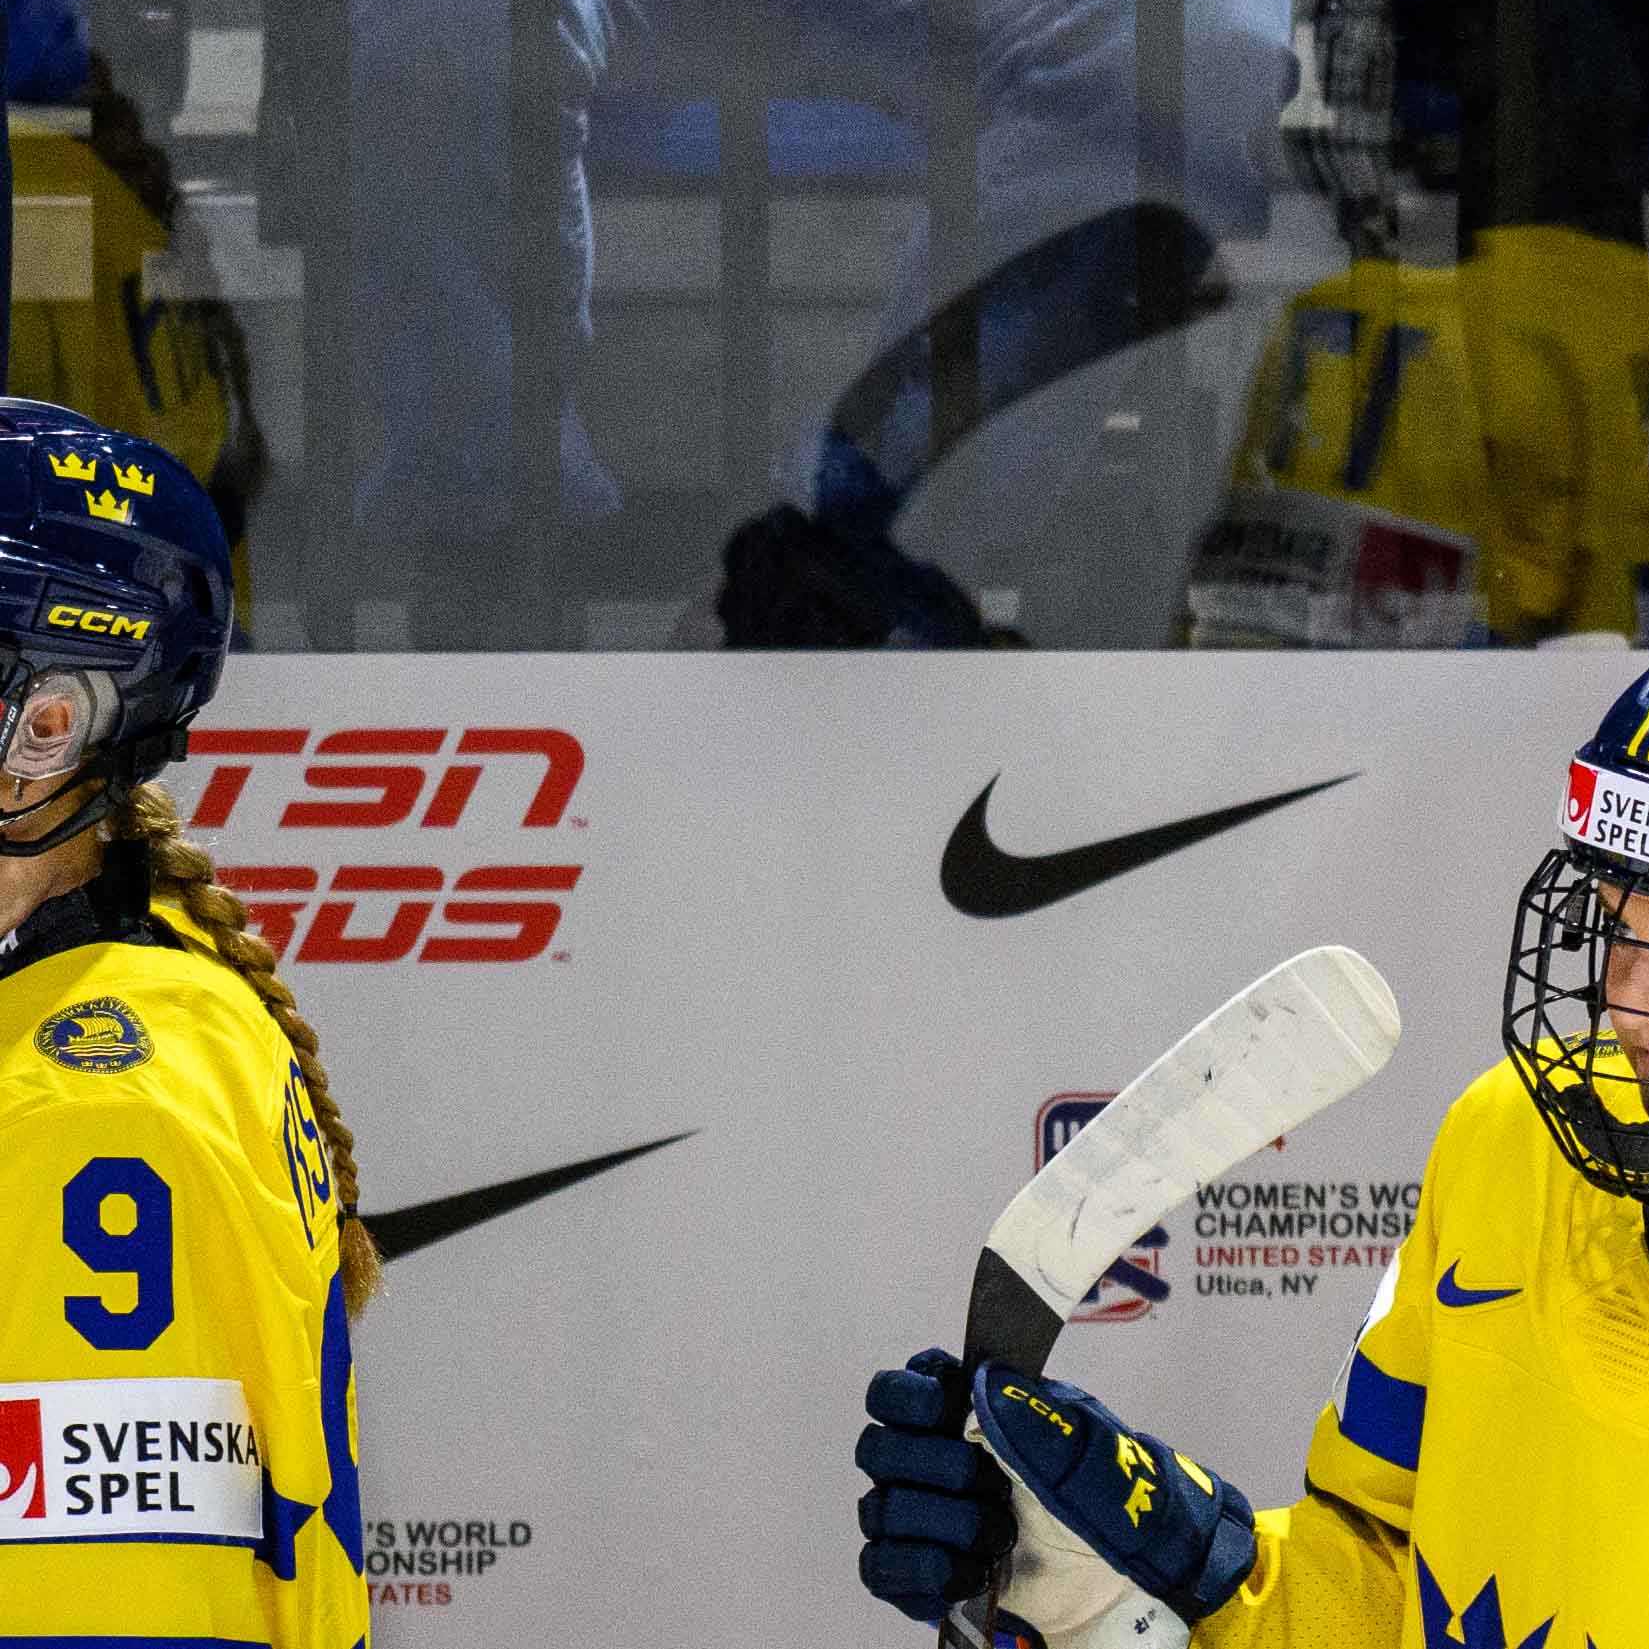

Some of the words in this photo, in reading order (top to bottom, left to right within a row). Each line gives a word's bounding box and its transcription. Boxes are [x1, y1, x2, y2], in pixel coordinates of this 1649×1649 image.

[48, 603, 151, 641] CCM
[187, 729, 586, 829] TSN
[1197, 1182, 1360, 1210] WOMEN'S
[61, 1156, 175, 1351] 9
[1196, 1245, 1300, 1268] UNITED
[1308, 1244, 1396, 1267] STATE
[1196, 1273, 1273, 1299] Utica,
[1281, 1274, 1320, 1296] NY
[1002, 1383, 1074, 1437] CCM
[62, 1420, 261, 1468] SVENSKA
[65, 1471, 196, 1516] SPEL
[405, 1520, 533, 1548] WORLD
[366, 1550, 497, 1576] ONSHIP
[367, 1582, 453, 1607] TATES
